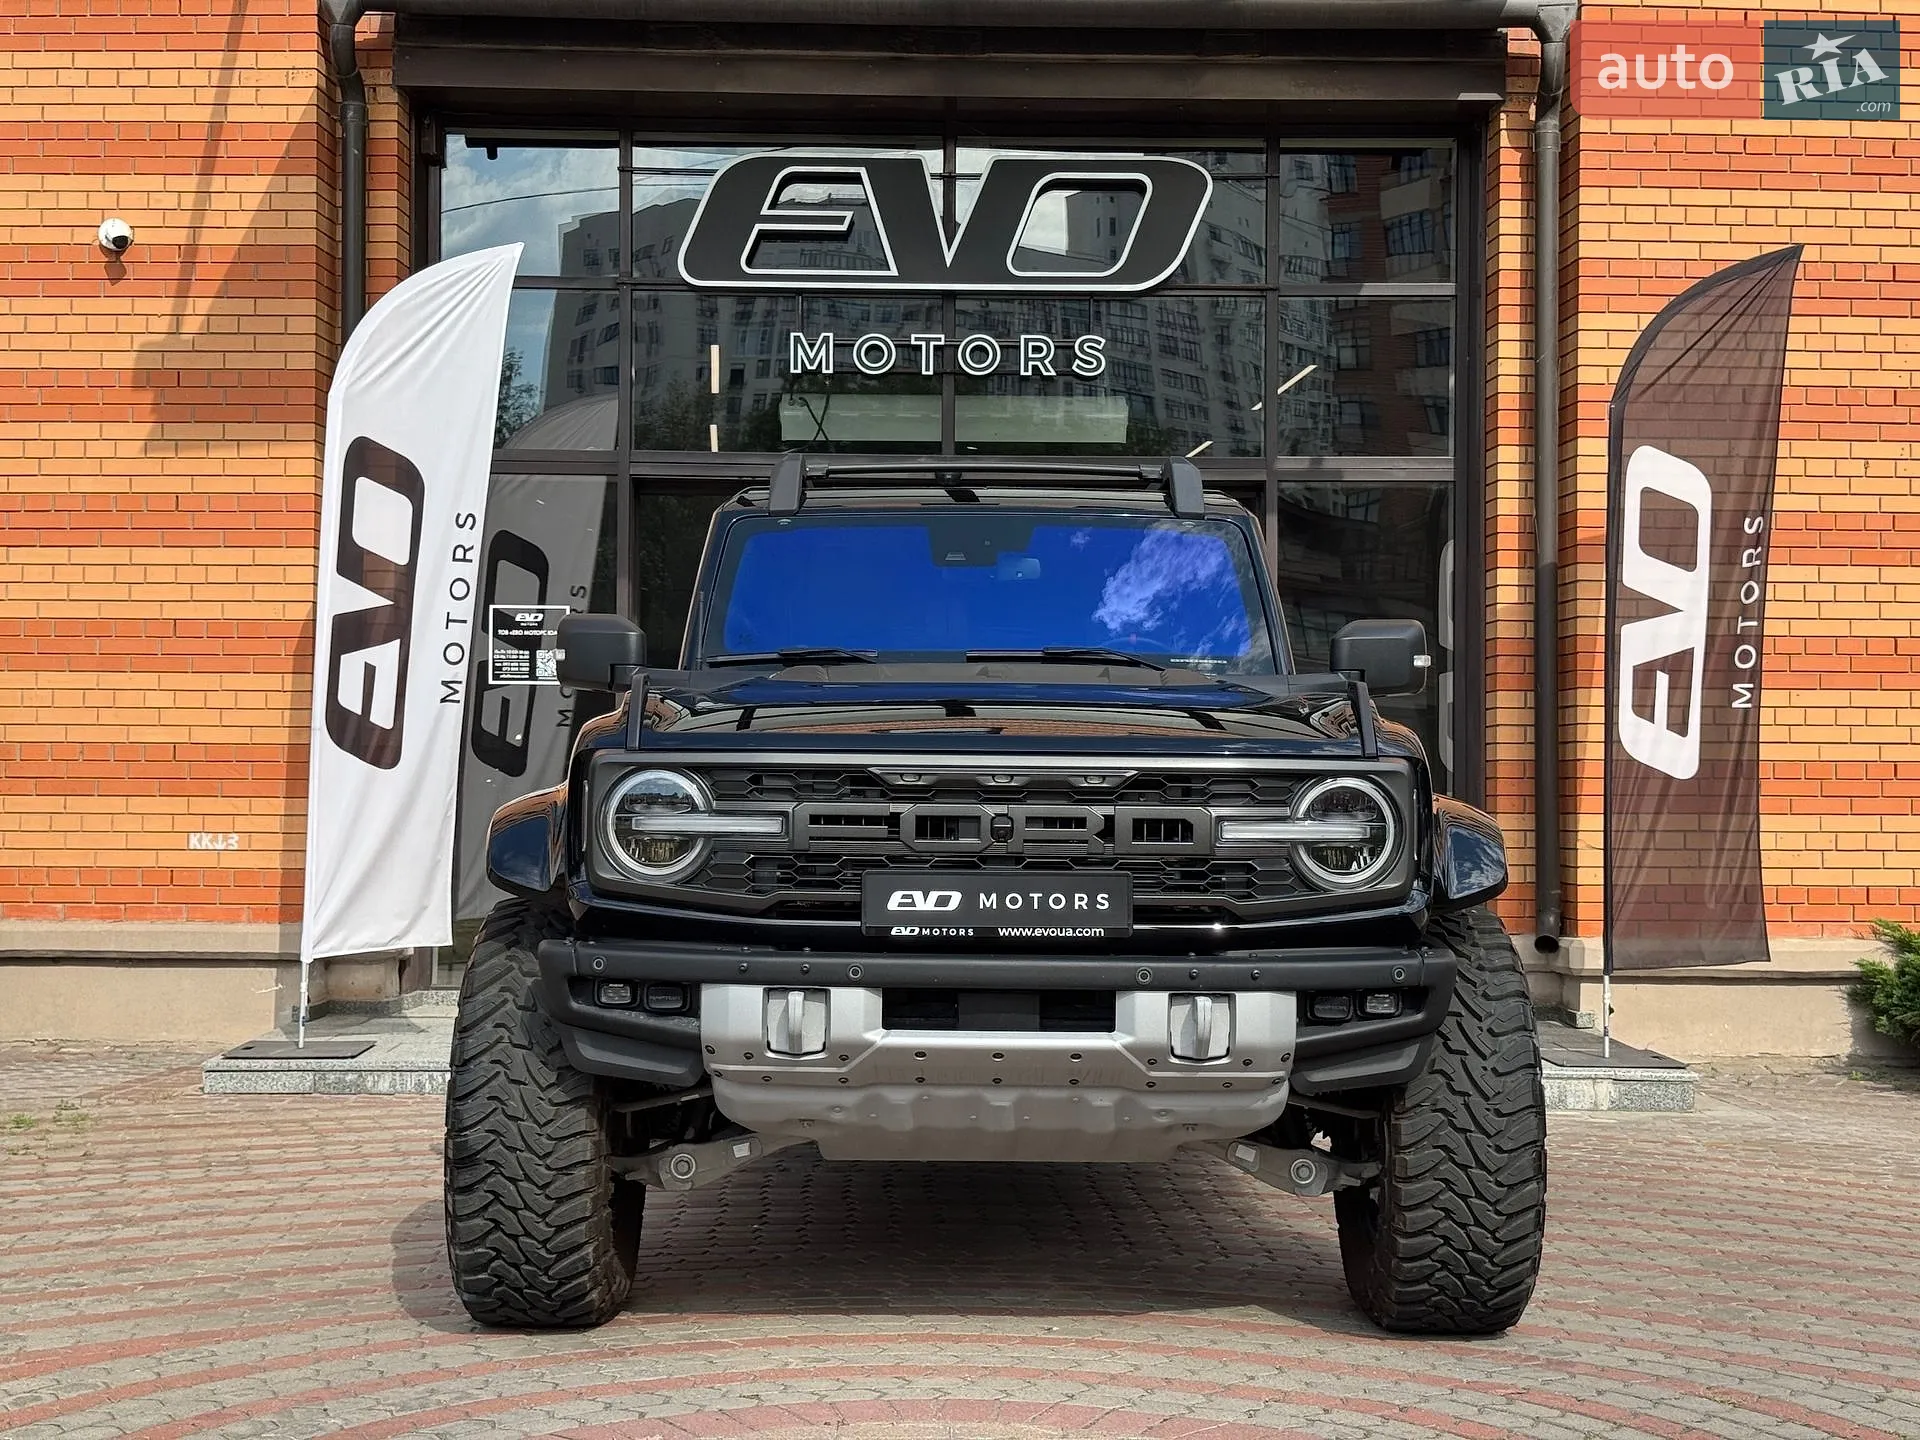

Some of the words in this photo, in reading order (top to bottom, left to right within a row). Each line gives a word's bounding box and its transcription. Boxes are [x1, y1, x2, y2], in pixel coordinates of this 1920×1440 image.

[677, 154, 1214, 292] EVO
[789, 332, 1107, 377] MOTORS
[325, 436, 425, 770] EVO
[439, 512, 477, 704] MOTORS
[1618, 445, 1712, 780] EVO
[1731, 515, 1764, 709] MOTORS
[793, 801, 1211, 854] FORD
[887, 890, 962, 911] EVO
[979, 892, 1110, 910] MOTORS
[890, 926, 919, 936] EVO
[921, 927, 974, 936] MOTORS
[998, 927, 1104, 938] www.evoua.com
